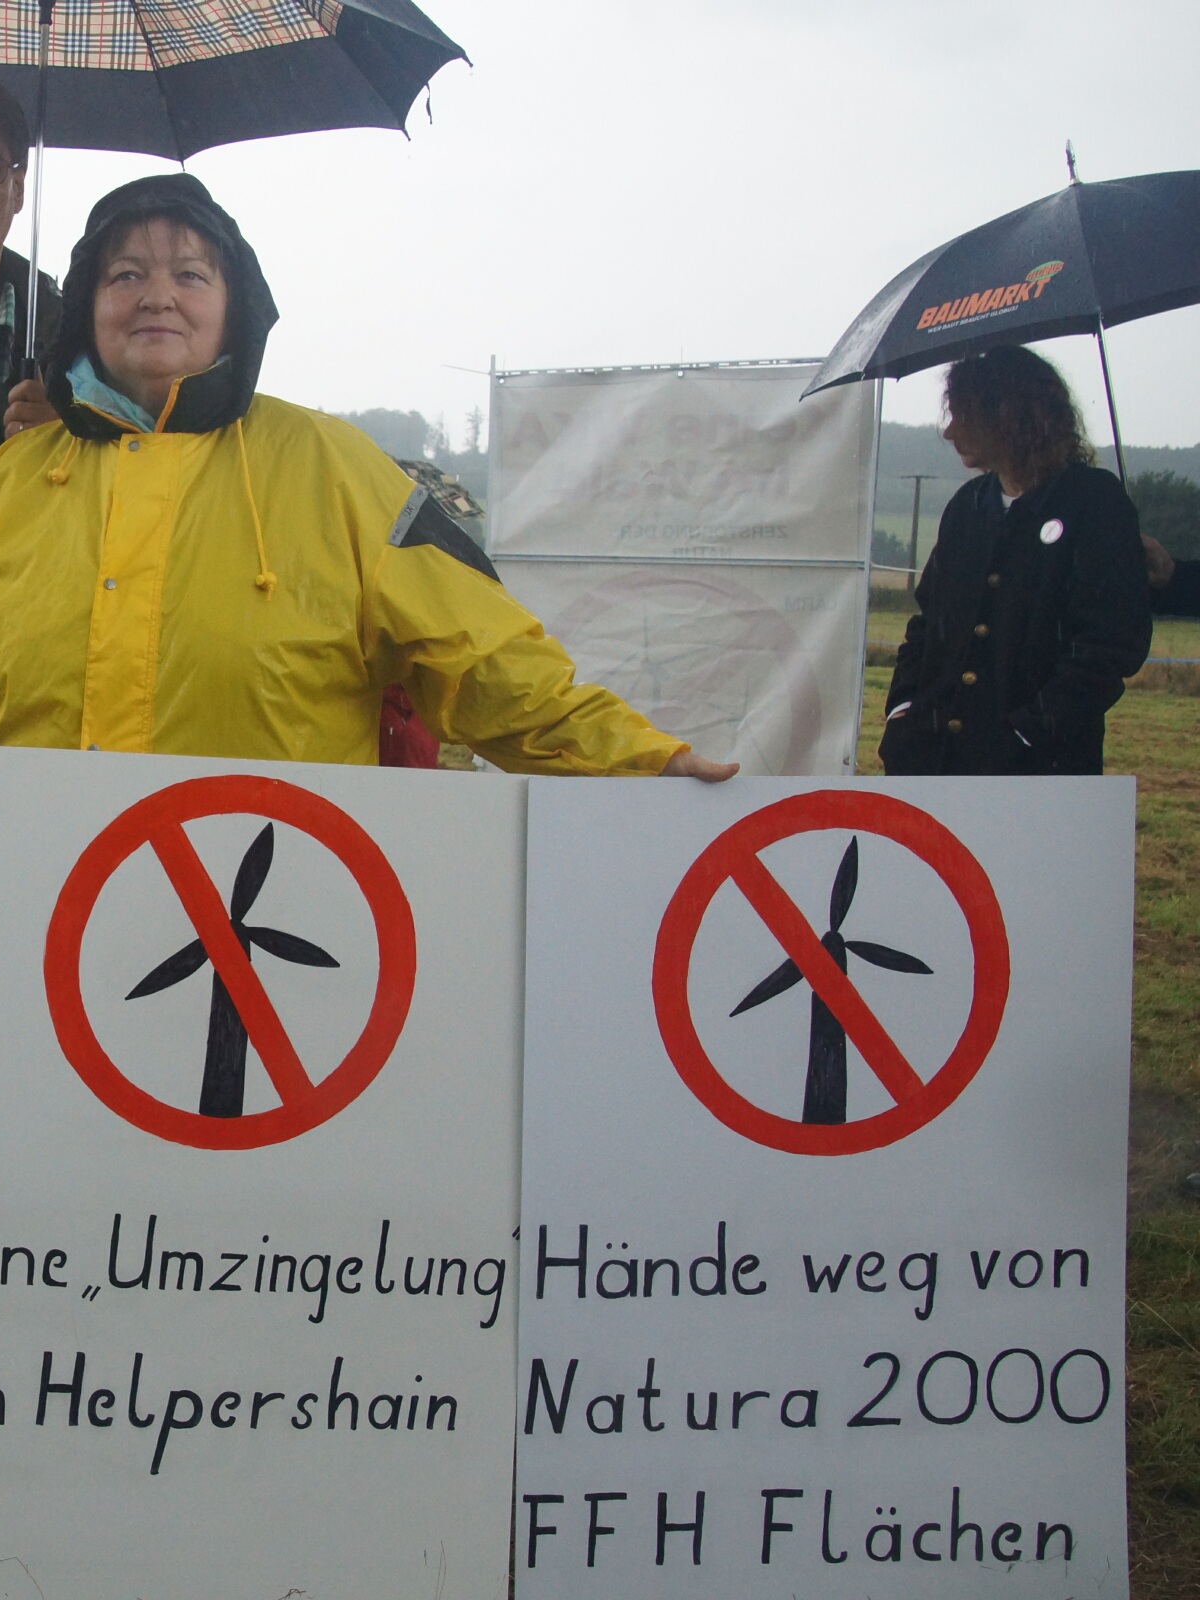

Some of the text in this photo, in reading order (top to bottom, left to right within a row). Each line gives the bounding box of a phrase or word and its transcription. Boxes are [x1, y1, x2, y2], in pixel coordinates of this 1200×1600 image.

[916, 276, 1052, 331] BAUMARKT
[1025, 260, 1065, 282] GLOBUS
[535, 1220, 1091, 1322] Hände weg von
[34, 1351, 459, 1476] Helpershain
[523, 1347, 1111, 1436] Natura 2000
[521, 1486, 1075, 1569] FFH Flächen
